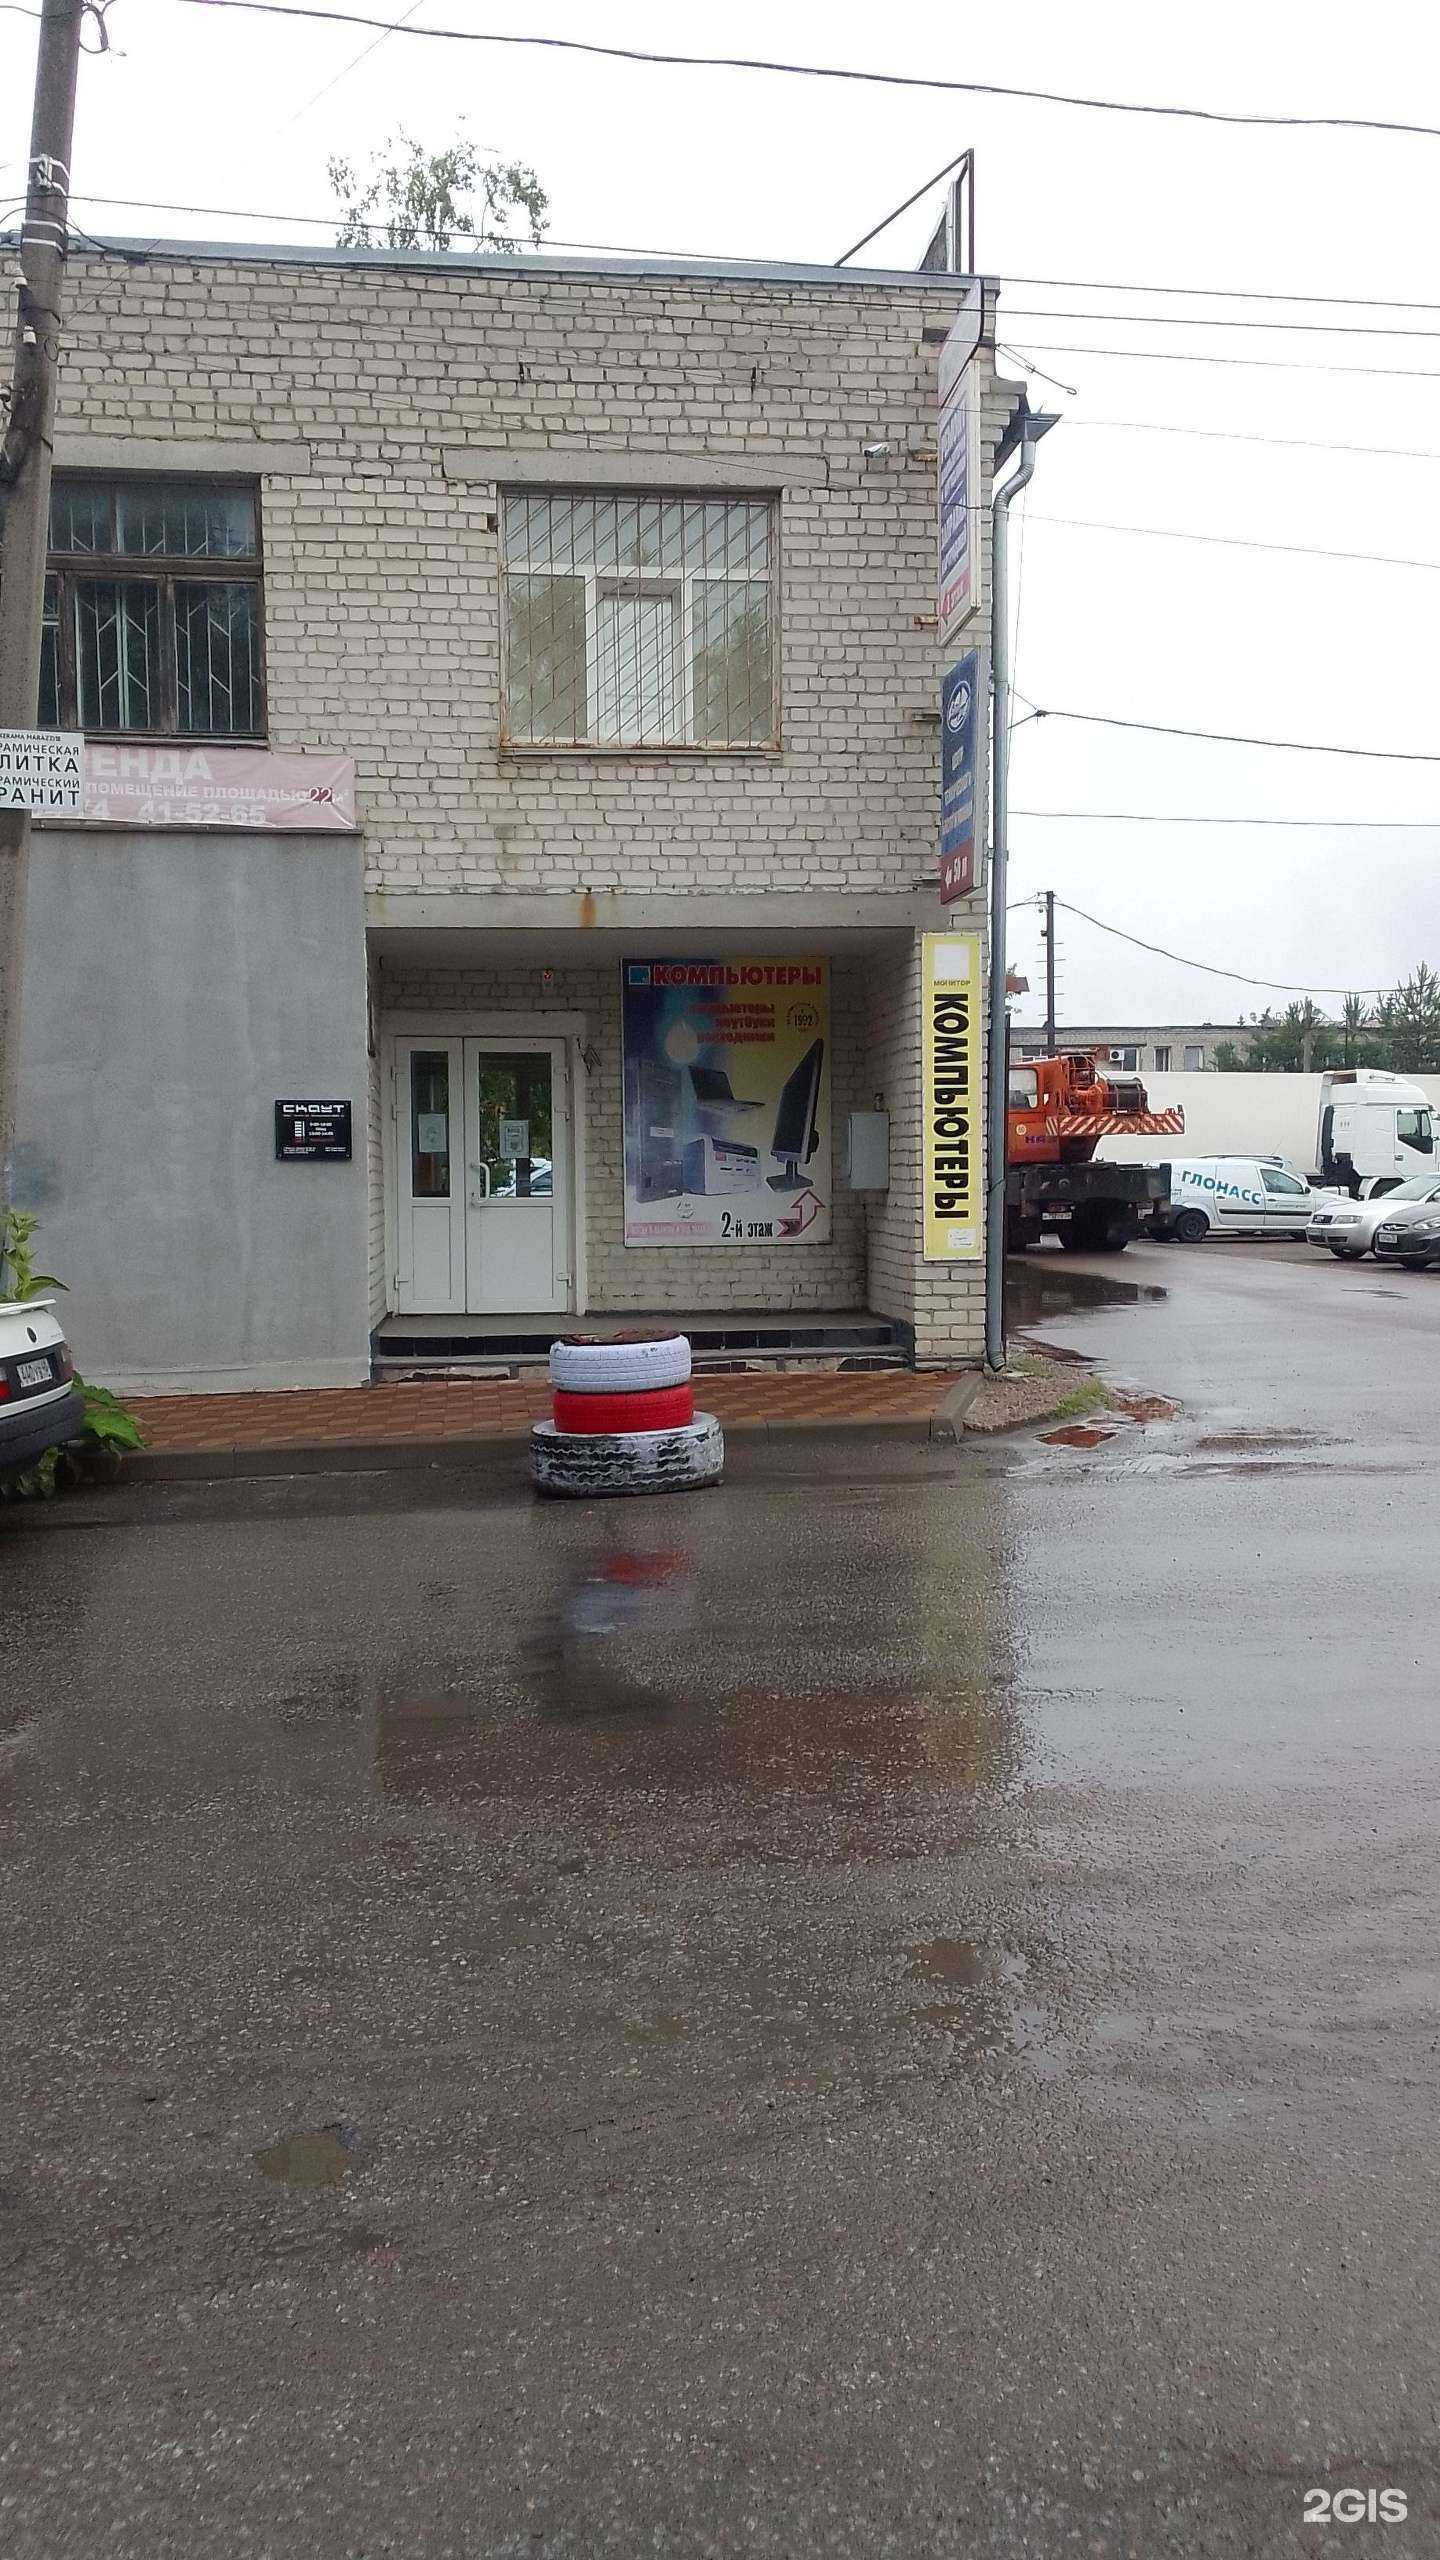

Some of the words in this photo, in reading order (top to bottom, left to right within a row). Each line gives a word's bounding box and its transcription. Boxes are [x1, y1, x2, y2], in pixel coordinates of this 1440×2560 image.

[0, 754, 79, 773] ЛИТКА
[653, 966, 823, 986] КОМПЬЮТЕРЫ
[934, 993, 969, 1218] КОМПЬЮТЕРЫ
[1181, 1170, 1261, 1205] ГЛОНАСС
[721, 1212, 743, 1238] 2-й
[747, 1223, 774, 1238] этаж
